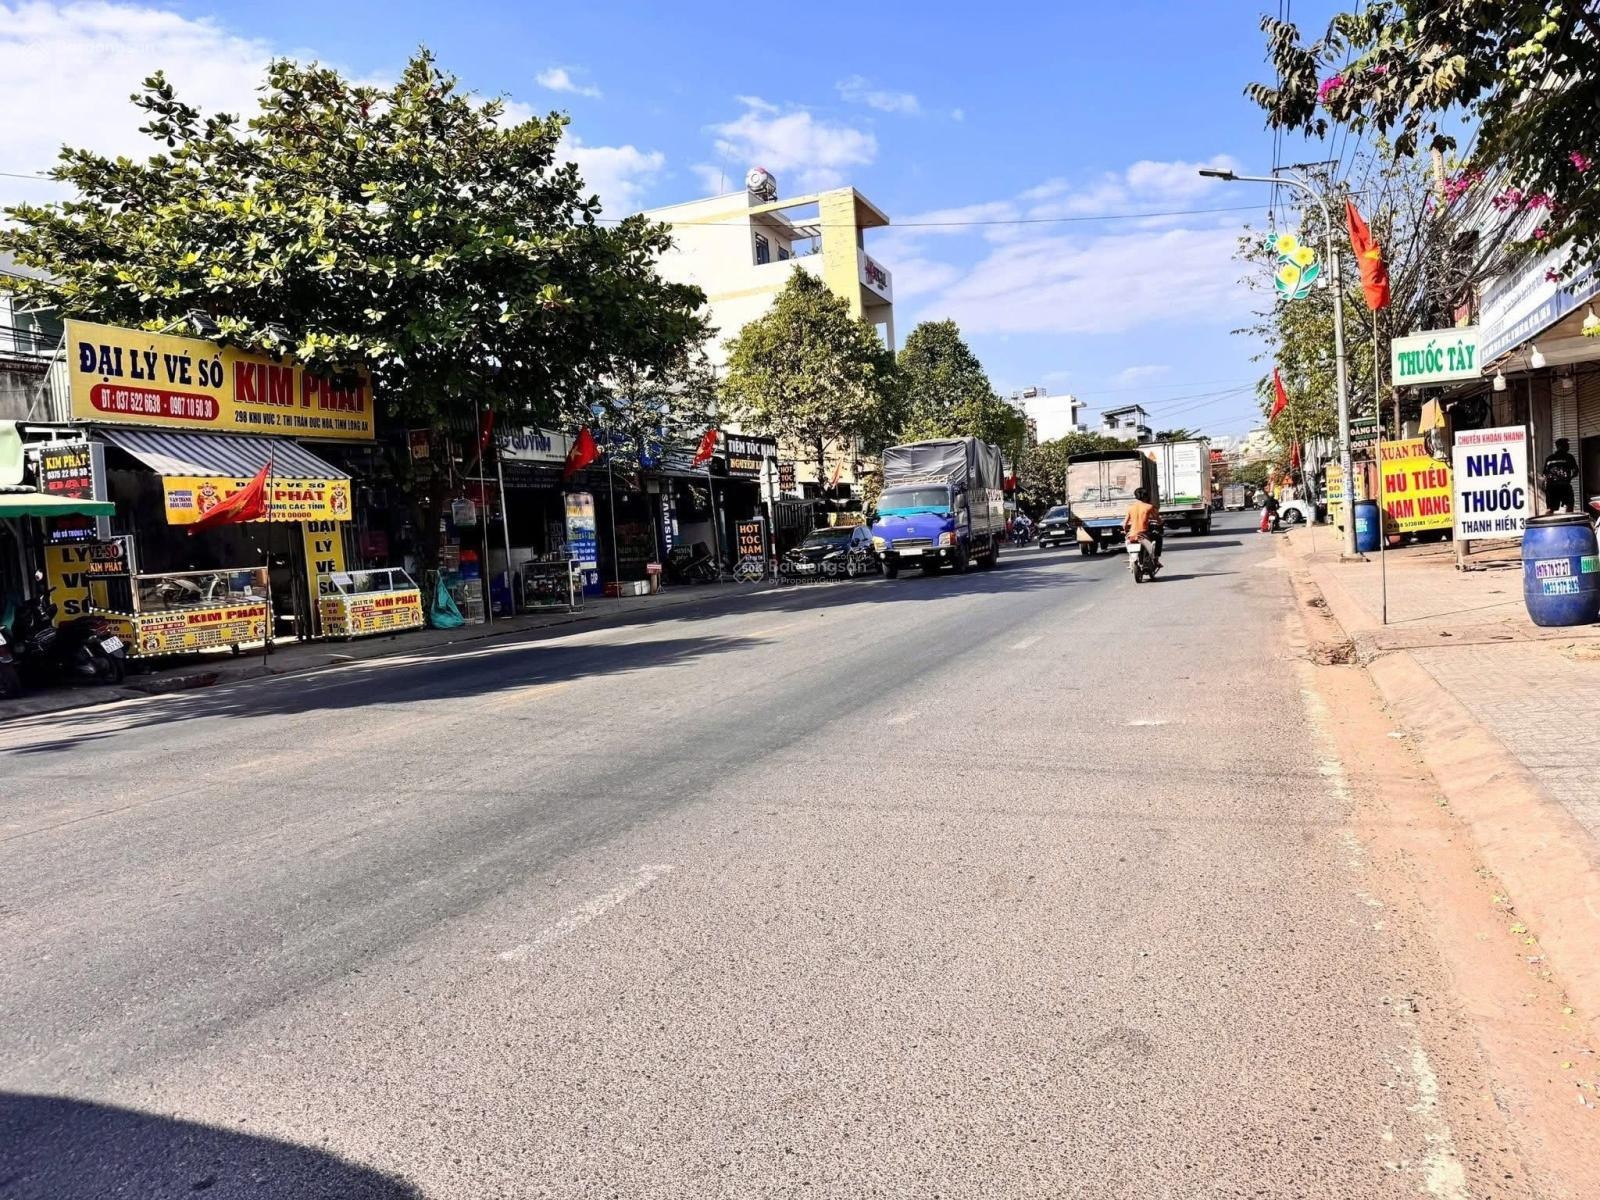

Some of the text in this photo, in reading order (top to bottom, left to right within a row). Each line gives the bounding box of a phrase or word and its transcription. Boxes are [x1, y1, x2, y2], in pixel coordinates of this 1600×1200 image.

[79, 342, 224, 388] ĐẠI LÝ VÉ SỐ
[1397, 339, 1476, 376] THUỐC TÂY
[233, 360, 294, 407] KIM
[116, 390, 129, 410] 037
[130, 392, 143, 412] 522
[144, 393, 161, 413] 6638
[170, 396, 186, 415] 0907
[186, 397, 195, 417] 10
[46, 456, 62, 470] KIM
[1466, 448, 1515, 477] NHÀ
[273, 488, 325, 502] PHÁT
[1461, 481, 1524, 513] THUỐC
[1387, 495, 1451, 519] NAM VANG
[1462, 519, 1492, 534] THANH
[740, 545, 763, 554] NAM
[316, 559, 336, 573] VÉ
[374, 597, 394, 608] KIM
[188, 607, 266, 625] KIM PHÁT
